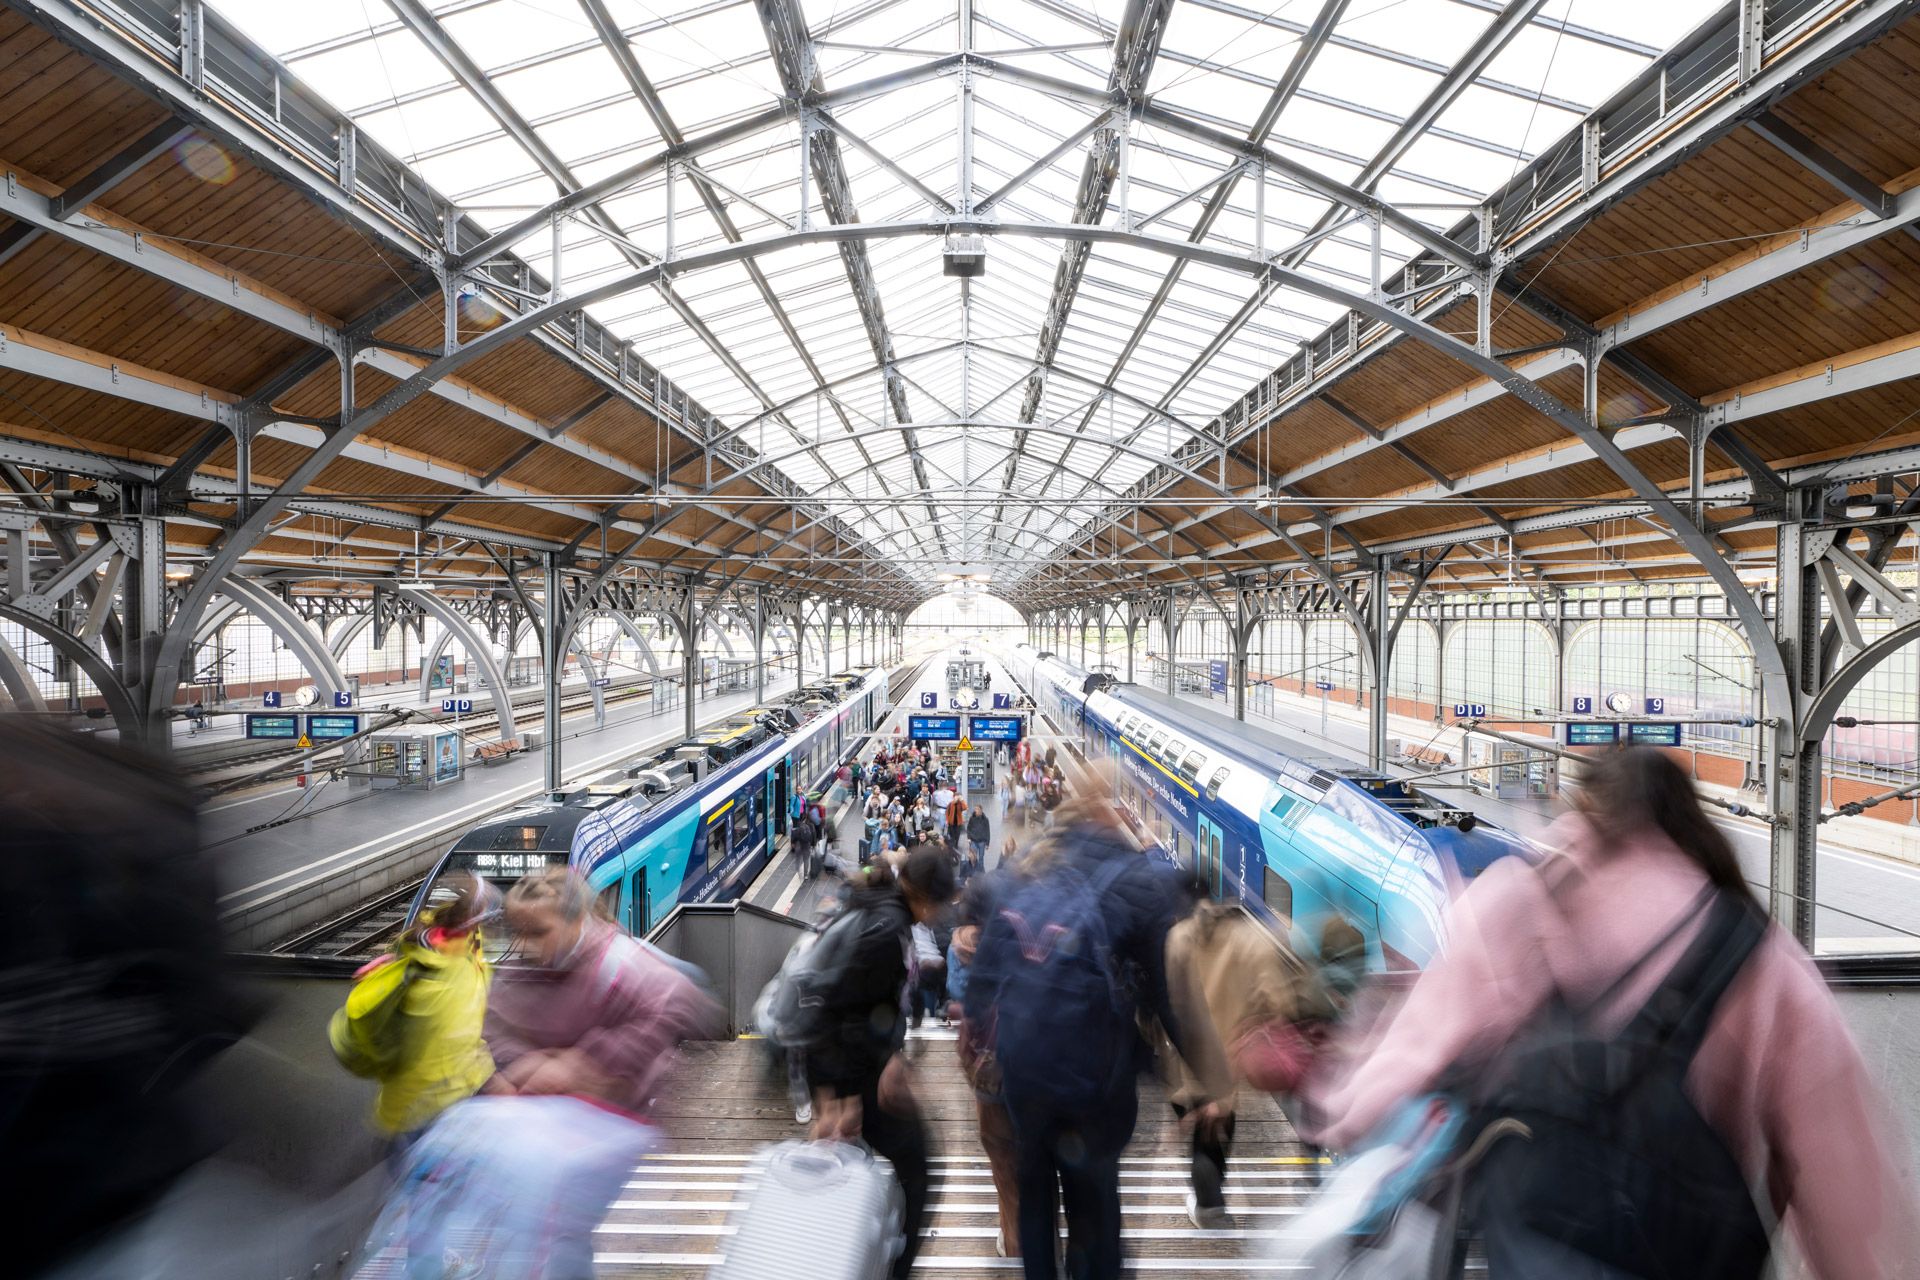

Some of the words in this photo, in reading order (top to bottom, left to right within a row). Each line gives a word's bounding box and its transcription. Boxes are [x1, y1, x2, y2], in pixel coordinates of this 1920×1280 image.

[265, 691, 274, 704] 4
[340, 692, 349, 704] 5
[923, 692, 932, 705] 6
[999, 694, 1008, 706] 7
[443, 700, 452, 710] D
[461, 700, 470, 710] D
[1457, 704, 1466, 715] D
[1475, 704, 1484, 715] D
[1577, 698, 1586, 710] 8
[1653, 699, 1662, 711] 9
[501, 854, 523, 867] Kiel
[527, 854, 546, 867] Hbf
